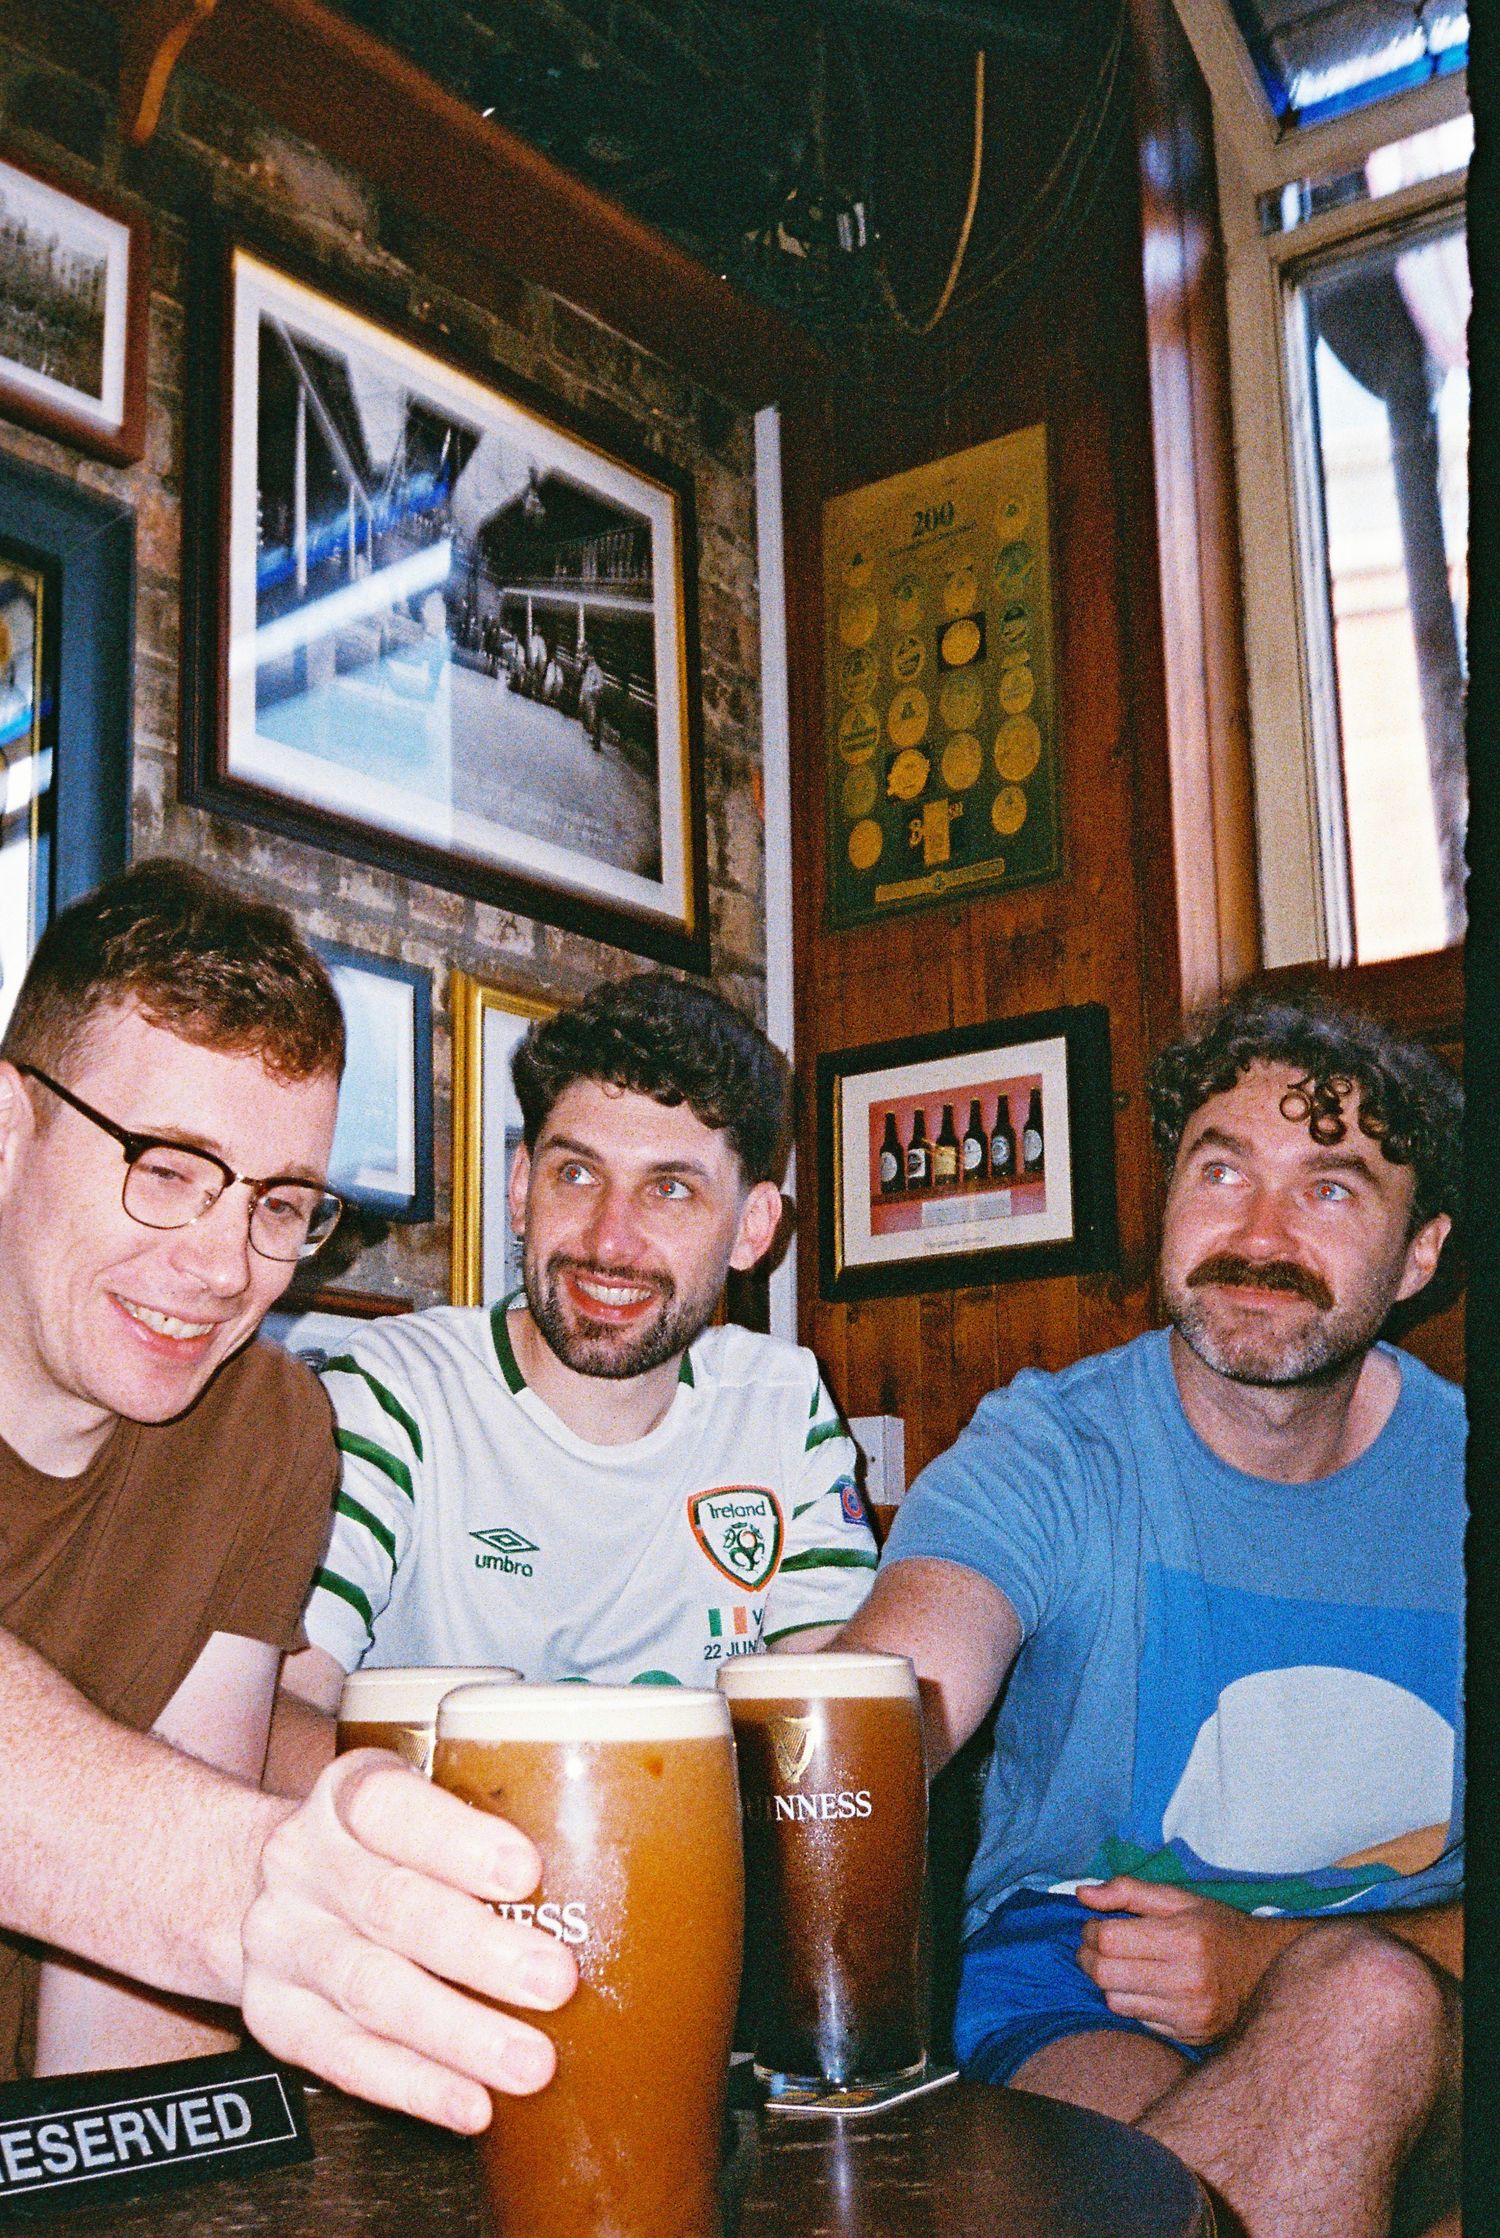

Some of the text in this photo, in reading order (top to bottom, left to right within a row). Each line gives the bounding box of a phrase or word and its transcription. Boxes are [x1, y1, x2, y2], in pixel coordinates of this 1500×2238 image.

[706, 1500, 767, 1519] Ireland
[475, 1554, 534, 1578] umbro
[704, 1644, 722, 1660] 22
[0, 2092, 252, 2183] ESERVED
